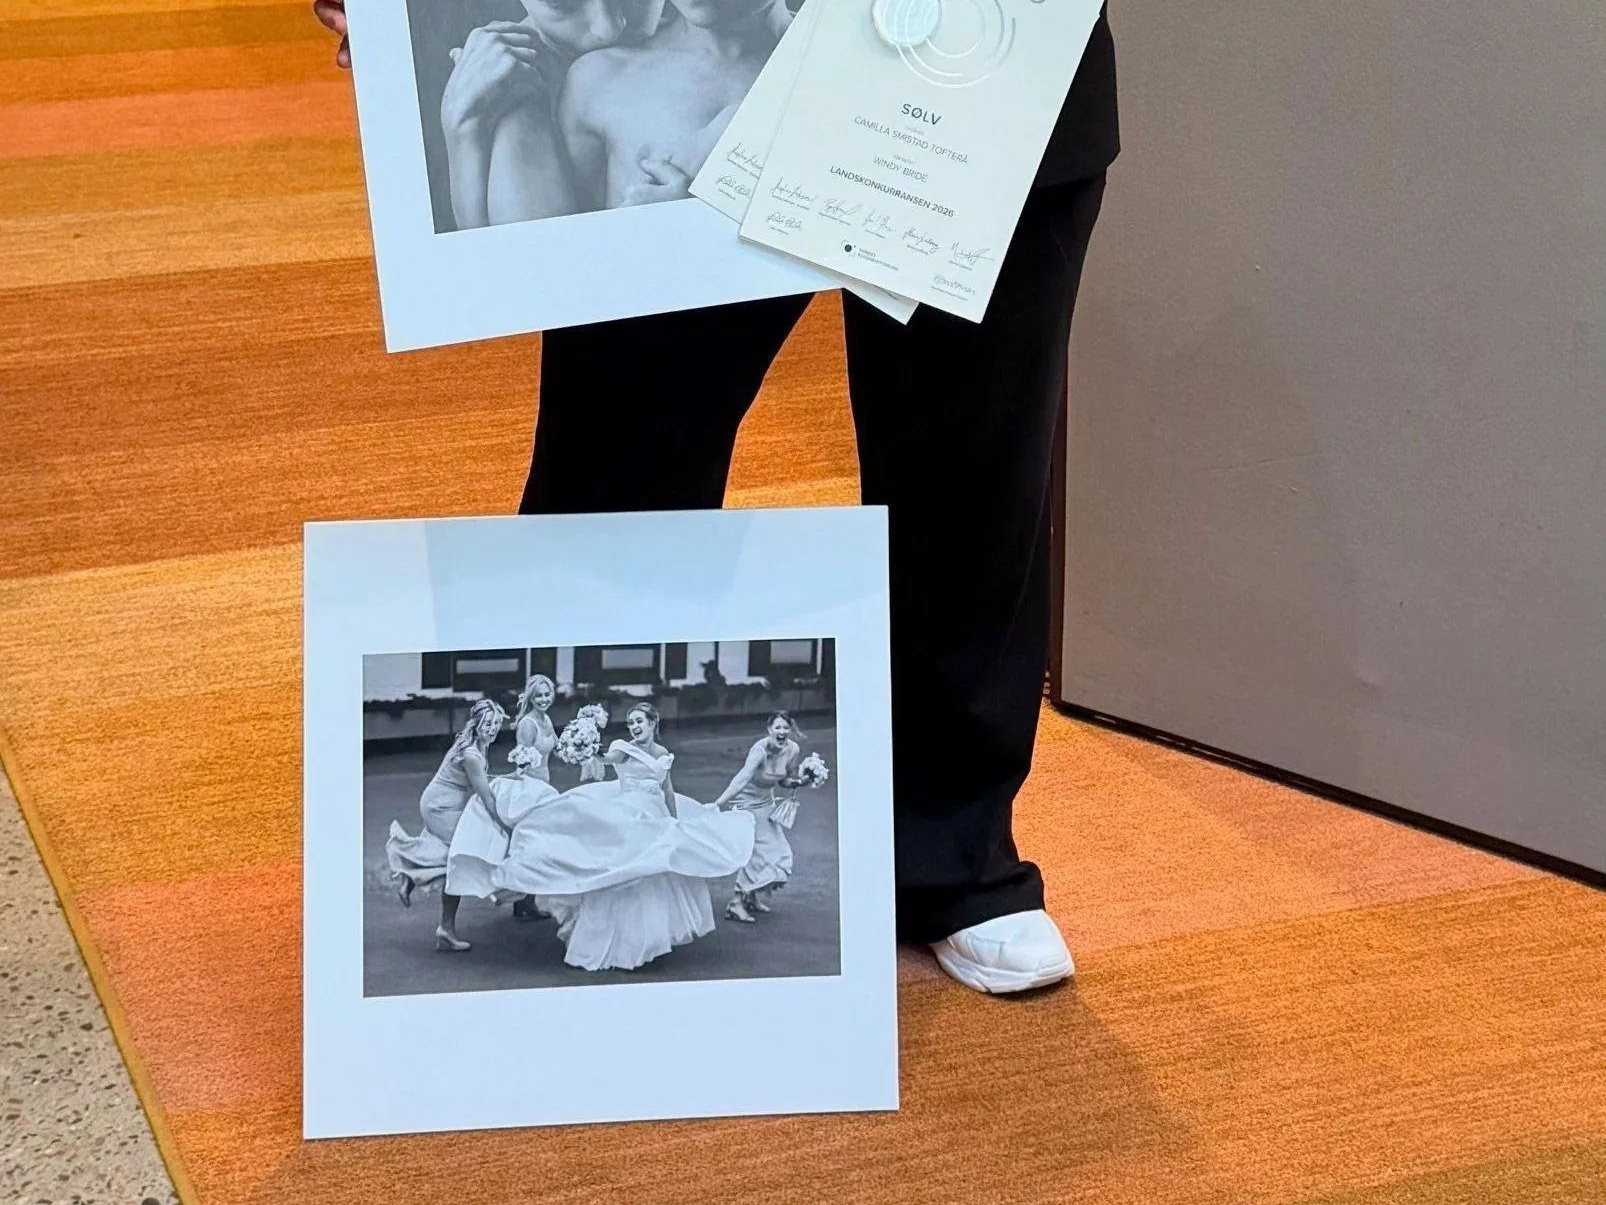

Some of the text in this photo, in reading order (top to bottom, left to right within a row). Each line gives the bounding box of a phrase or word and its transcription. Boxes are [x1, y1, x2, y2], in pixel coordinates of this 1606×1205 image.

[901, 103, 941, 125] SØLV
[854, 116, 890, 135] CAMILLA
[892, 130, 929, 149] SMISTAD
[873, 156, 902, 172] WINDY
[902, 167, 928, 183] BRIDE
[830, 165, 931, 209] LANDSKONKURRANSEN
[931, 203, 954, 217] 2026
